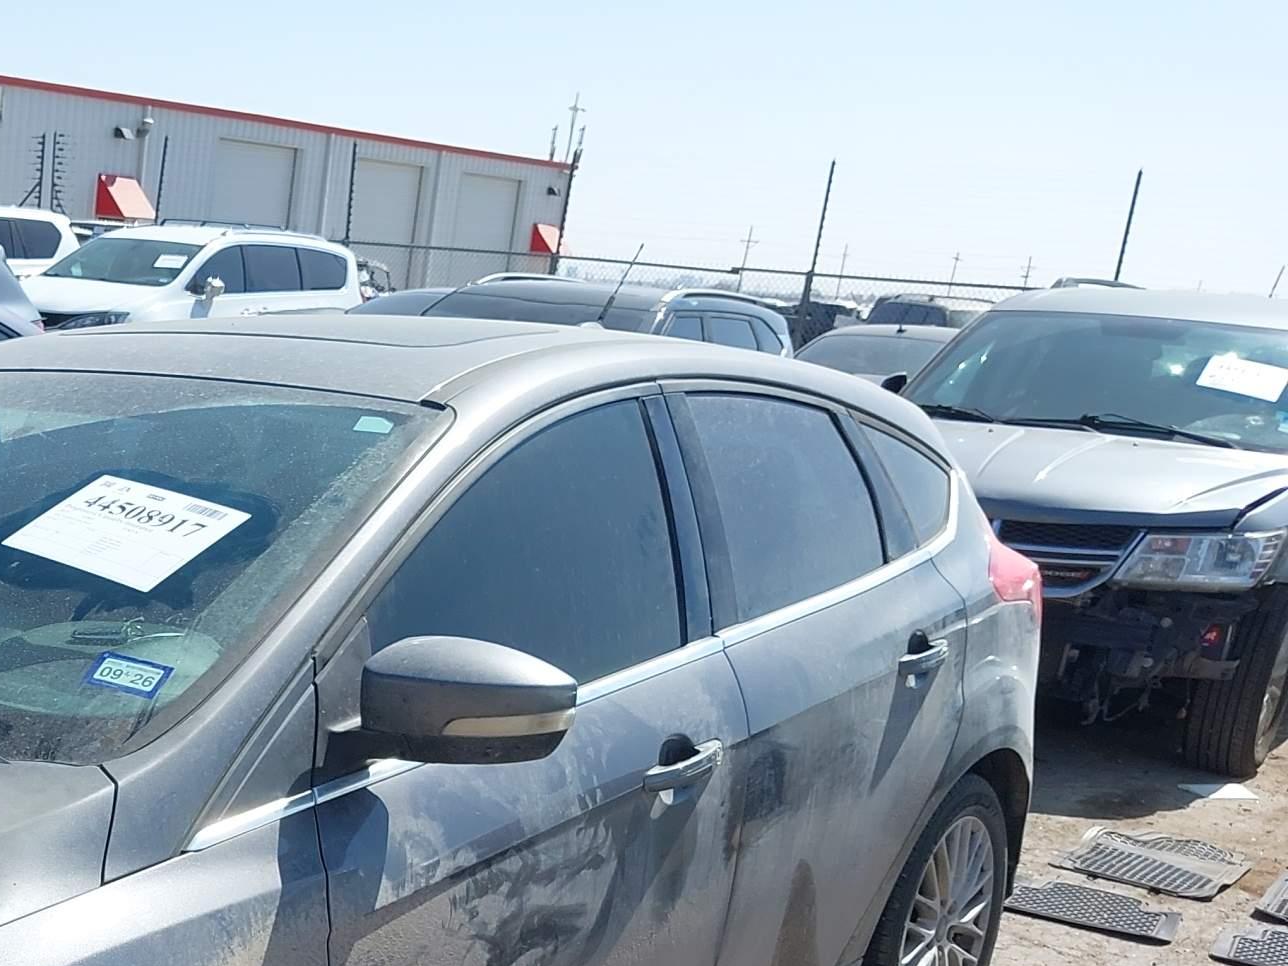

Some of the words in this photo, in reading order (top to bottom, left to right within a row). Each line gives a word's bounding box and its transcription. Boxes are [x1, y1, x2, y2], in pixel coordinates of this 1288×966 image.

[83, 495, 208, 537] 44508917
[99, 666, 124, 680] 09
[129, 673, 155, 687] 26
